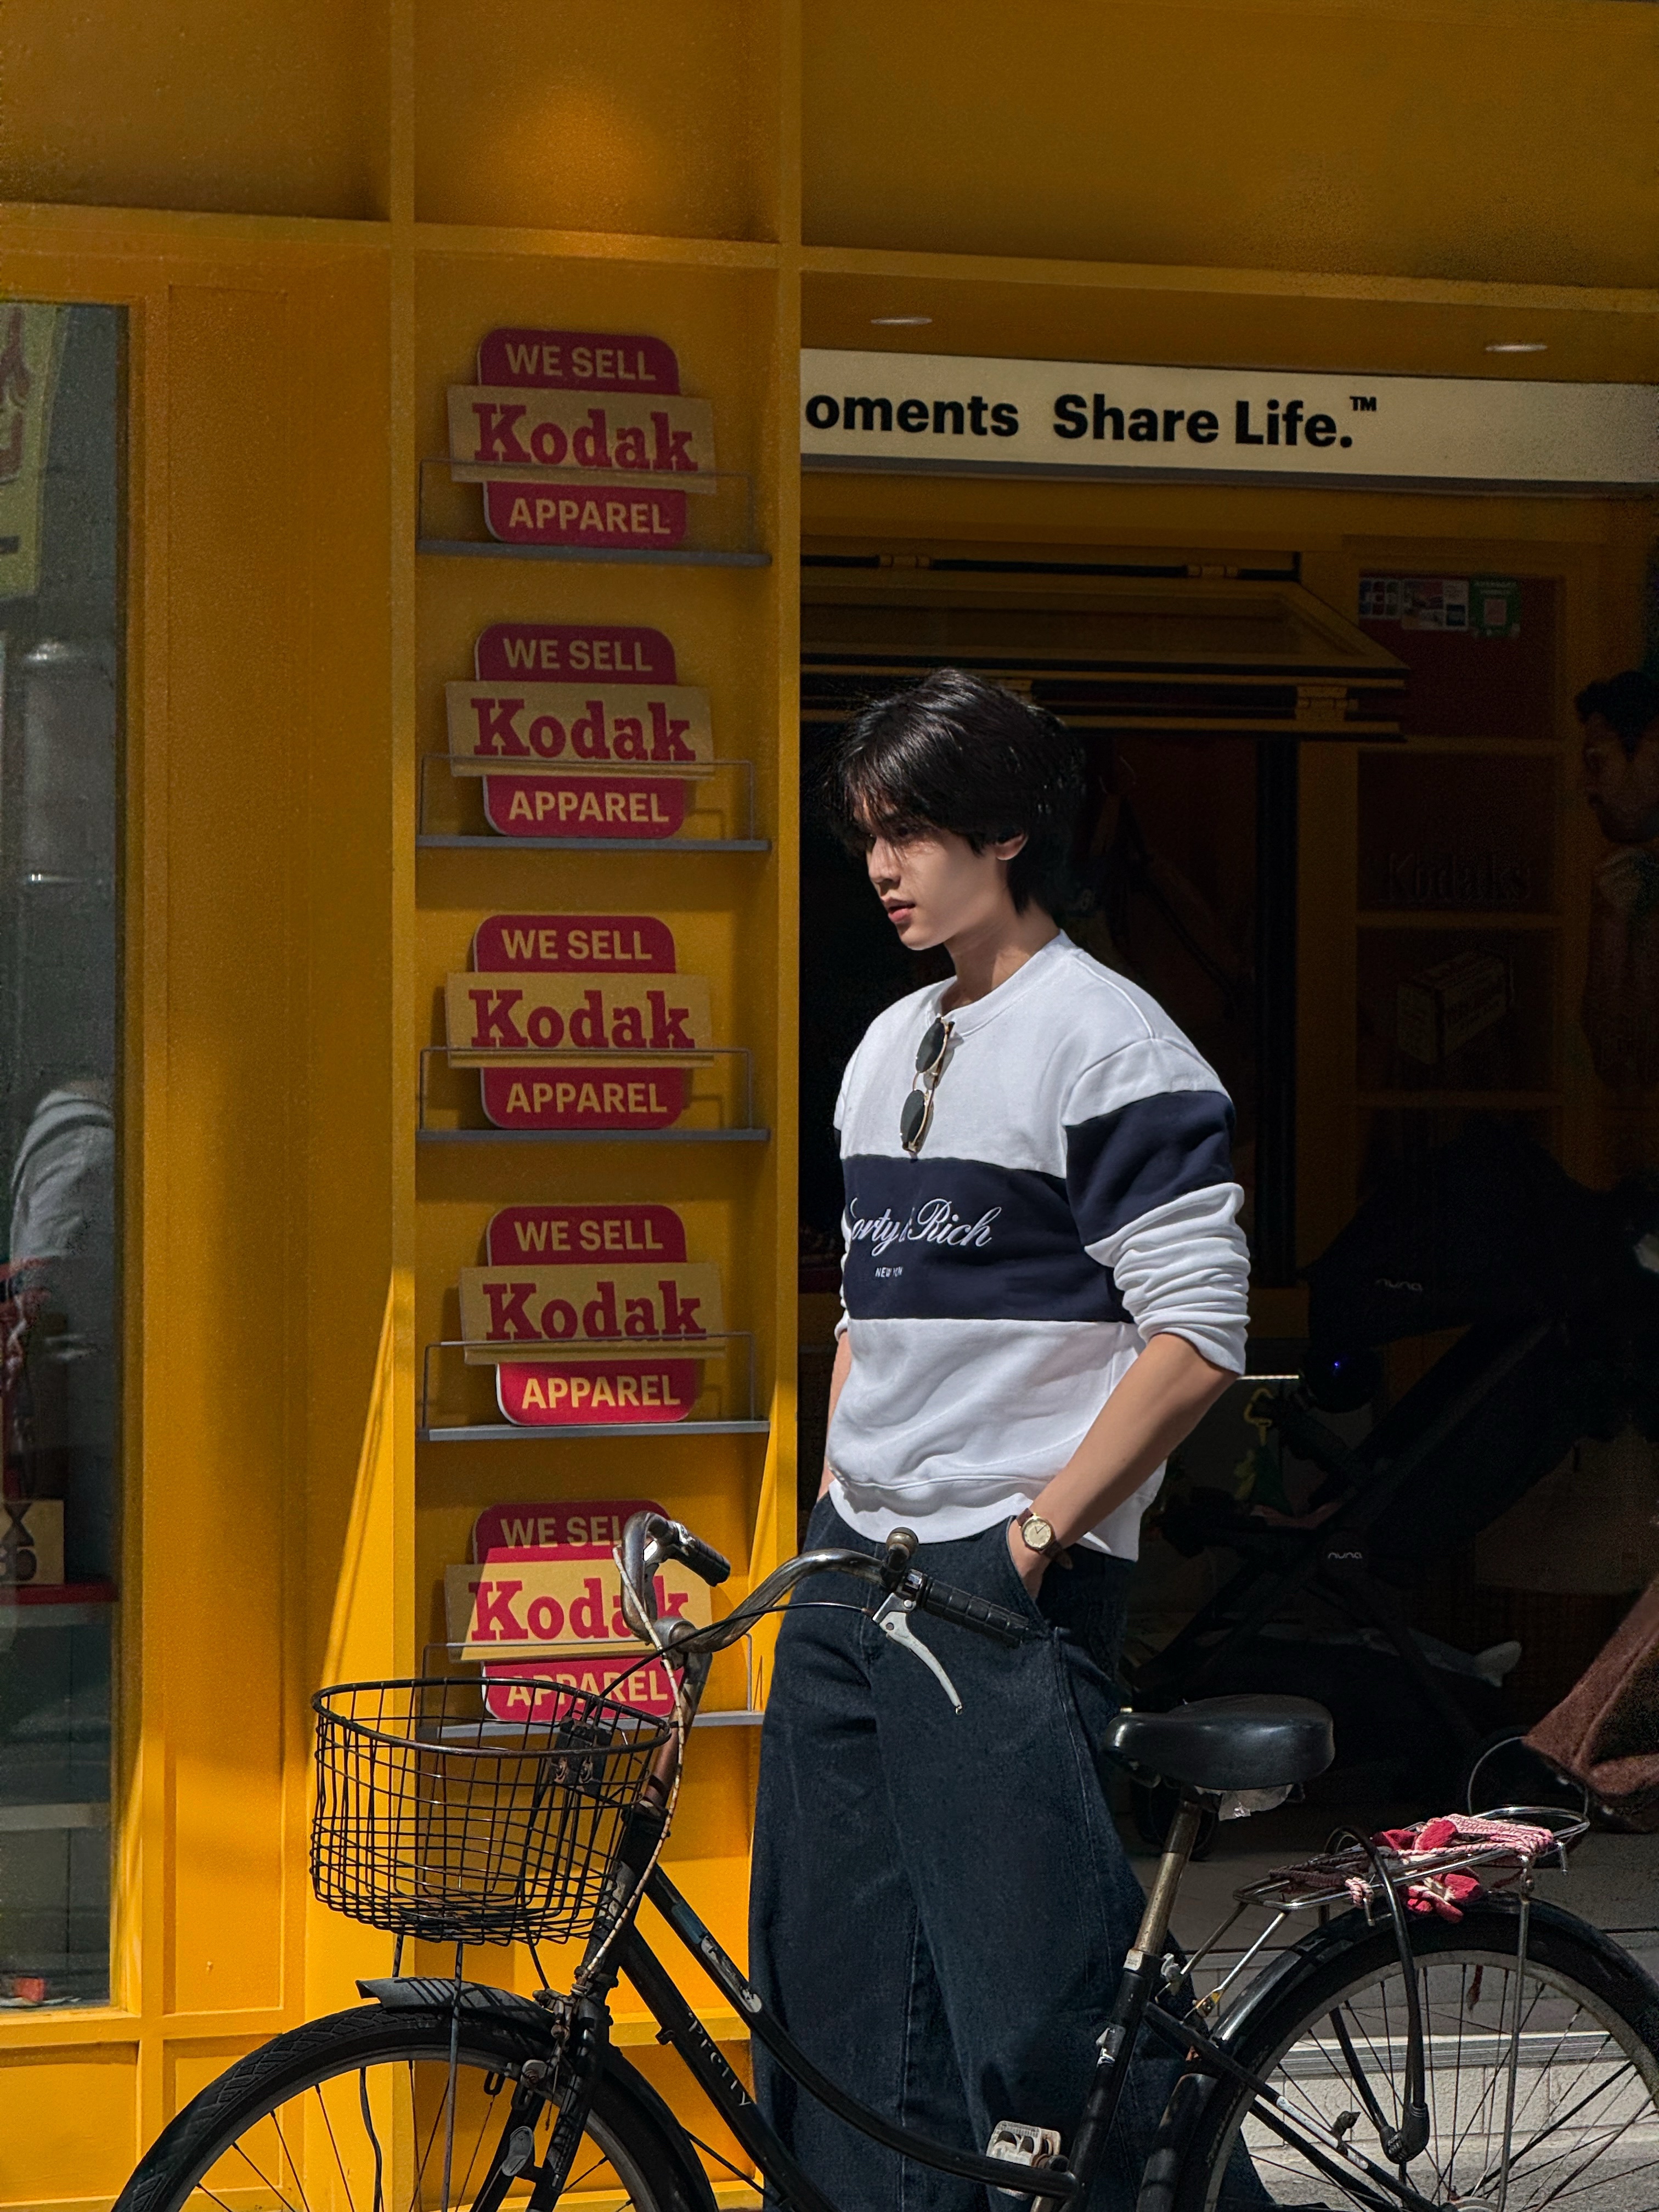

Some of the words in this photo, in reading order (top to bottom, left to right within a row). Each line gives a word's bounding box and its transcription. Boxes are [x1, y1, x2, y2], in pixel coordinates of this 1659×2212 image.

[505, 343, 563, 376] WE
[571, 346, 657, 381] SELL
[805, 393, 1019, 437] oments
[1053, 393, 1219, 443] Share
[472, 402, 698, 472] Kodak
[509, 498, 671, 535] APPAREL
[503, 637, 560, 671] WE
[568, 640, 653, 672] SELL
[471, 698, 696, 762] Kodak
[509, 791, 669, 823] APPAREL
[501, 929, 558, 960] WE
[567, 930, 653, 961] SELL
[469, 989, 695, 1049] Kodak
[506, 1082, 668, 1114] APPAREL
[514, 1220, 571, 1252] WE
[579, 1219, 664, 1251] SELL
[907, 1198, 1002, 1248] Rich
[483, 1280, 707, 1342] Kodak
[521, 1374, 681, 1410] APPAREL
[500, 1517, 556, 1549] WE
[566, 1515, 624, 1547] SEL
